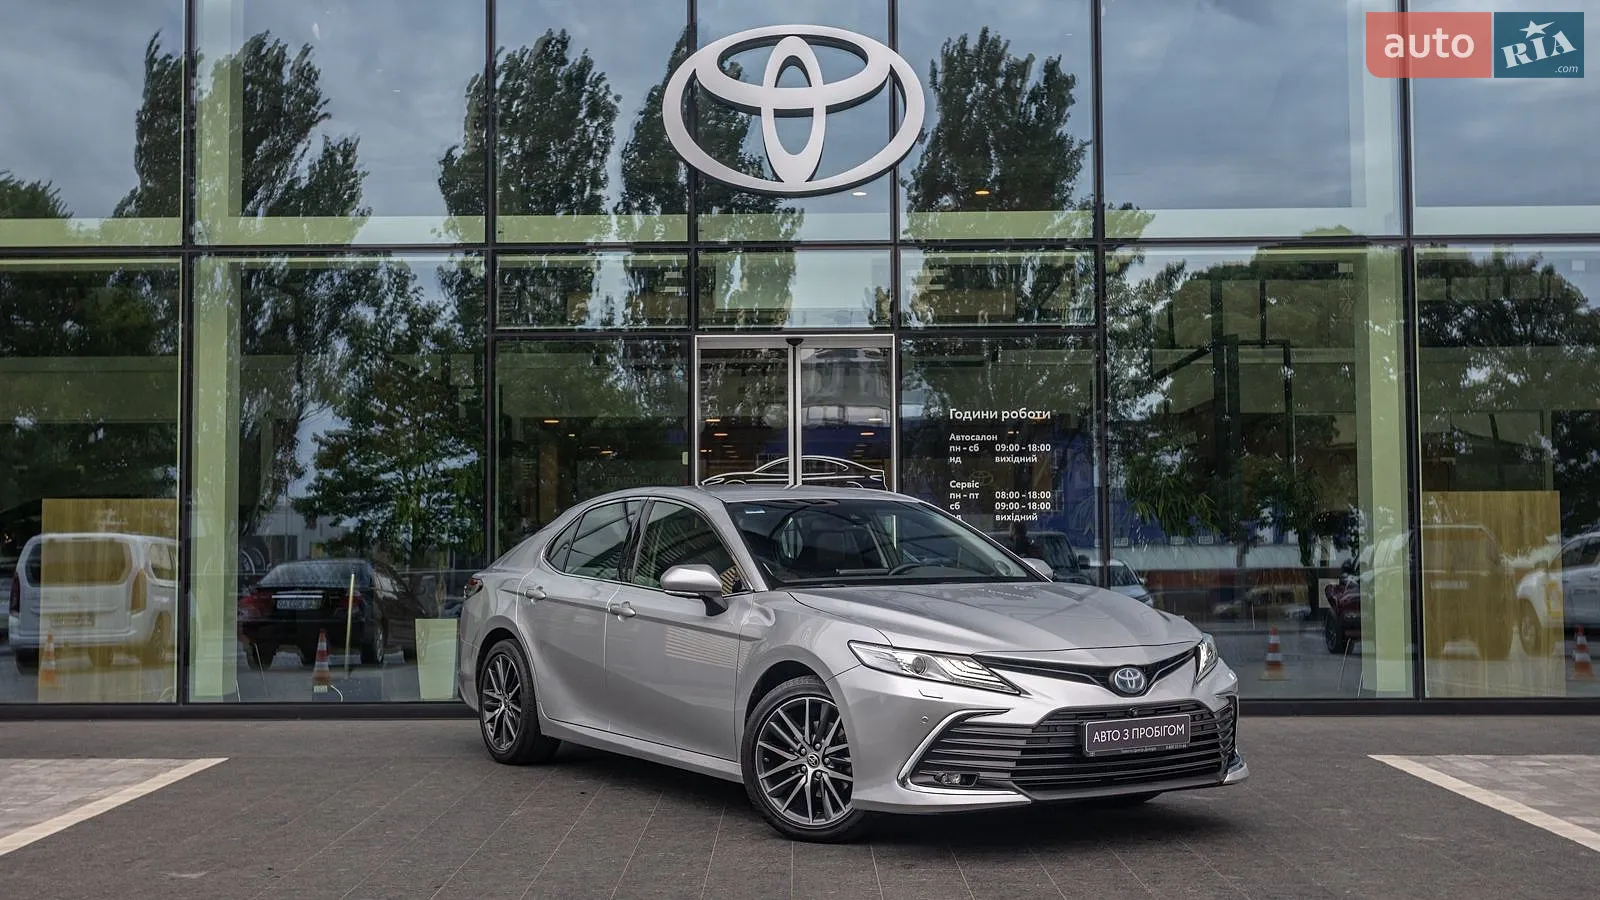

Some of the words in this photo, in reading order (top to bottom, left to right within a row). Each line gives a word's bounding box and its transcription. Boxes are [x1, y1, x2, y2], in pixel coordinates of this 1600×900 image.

[949, 408, 998, 421] Години
[1001, 407, 1051, 421] роботи
[949, 433, 998, 441] Автосалон
[968, 443, 980, 452] сб
[995, 443, 1020, 452] 09:00
[1028, 443, 1051, 452] 18:00
[995, 454, 1038, 463] вихідний
[949, 480, 980, 490] Сервіс
[995, 491, 1020, 499] 08:00
[1028, 491, 1051, 499] 18:00
[949, 501, 961, 510] сб
[995, 501, 1020, 510] 09:00
[1028, 501, 1051, 510] 18:00
[995, 512, 1038, 522] вихідний
[1093, 729, 1121, 743] АВТО
[1131, 724, 1185, 740] ПРОБІГОМ
